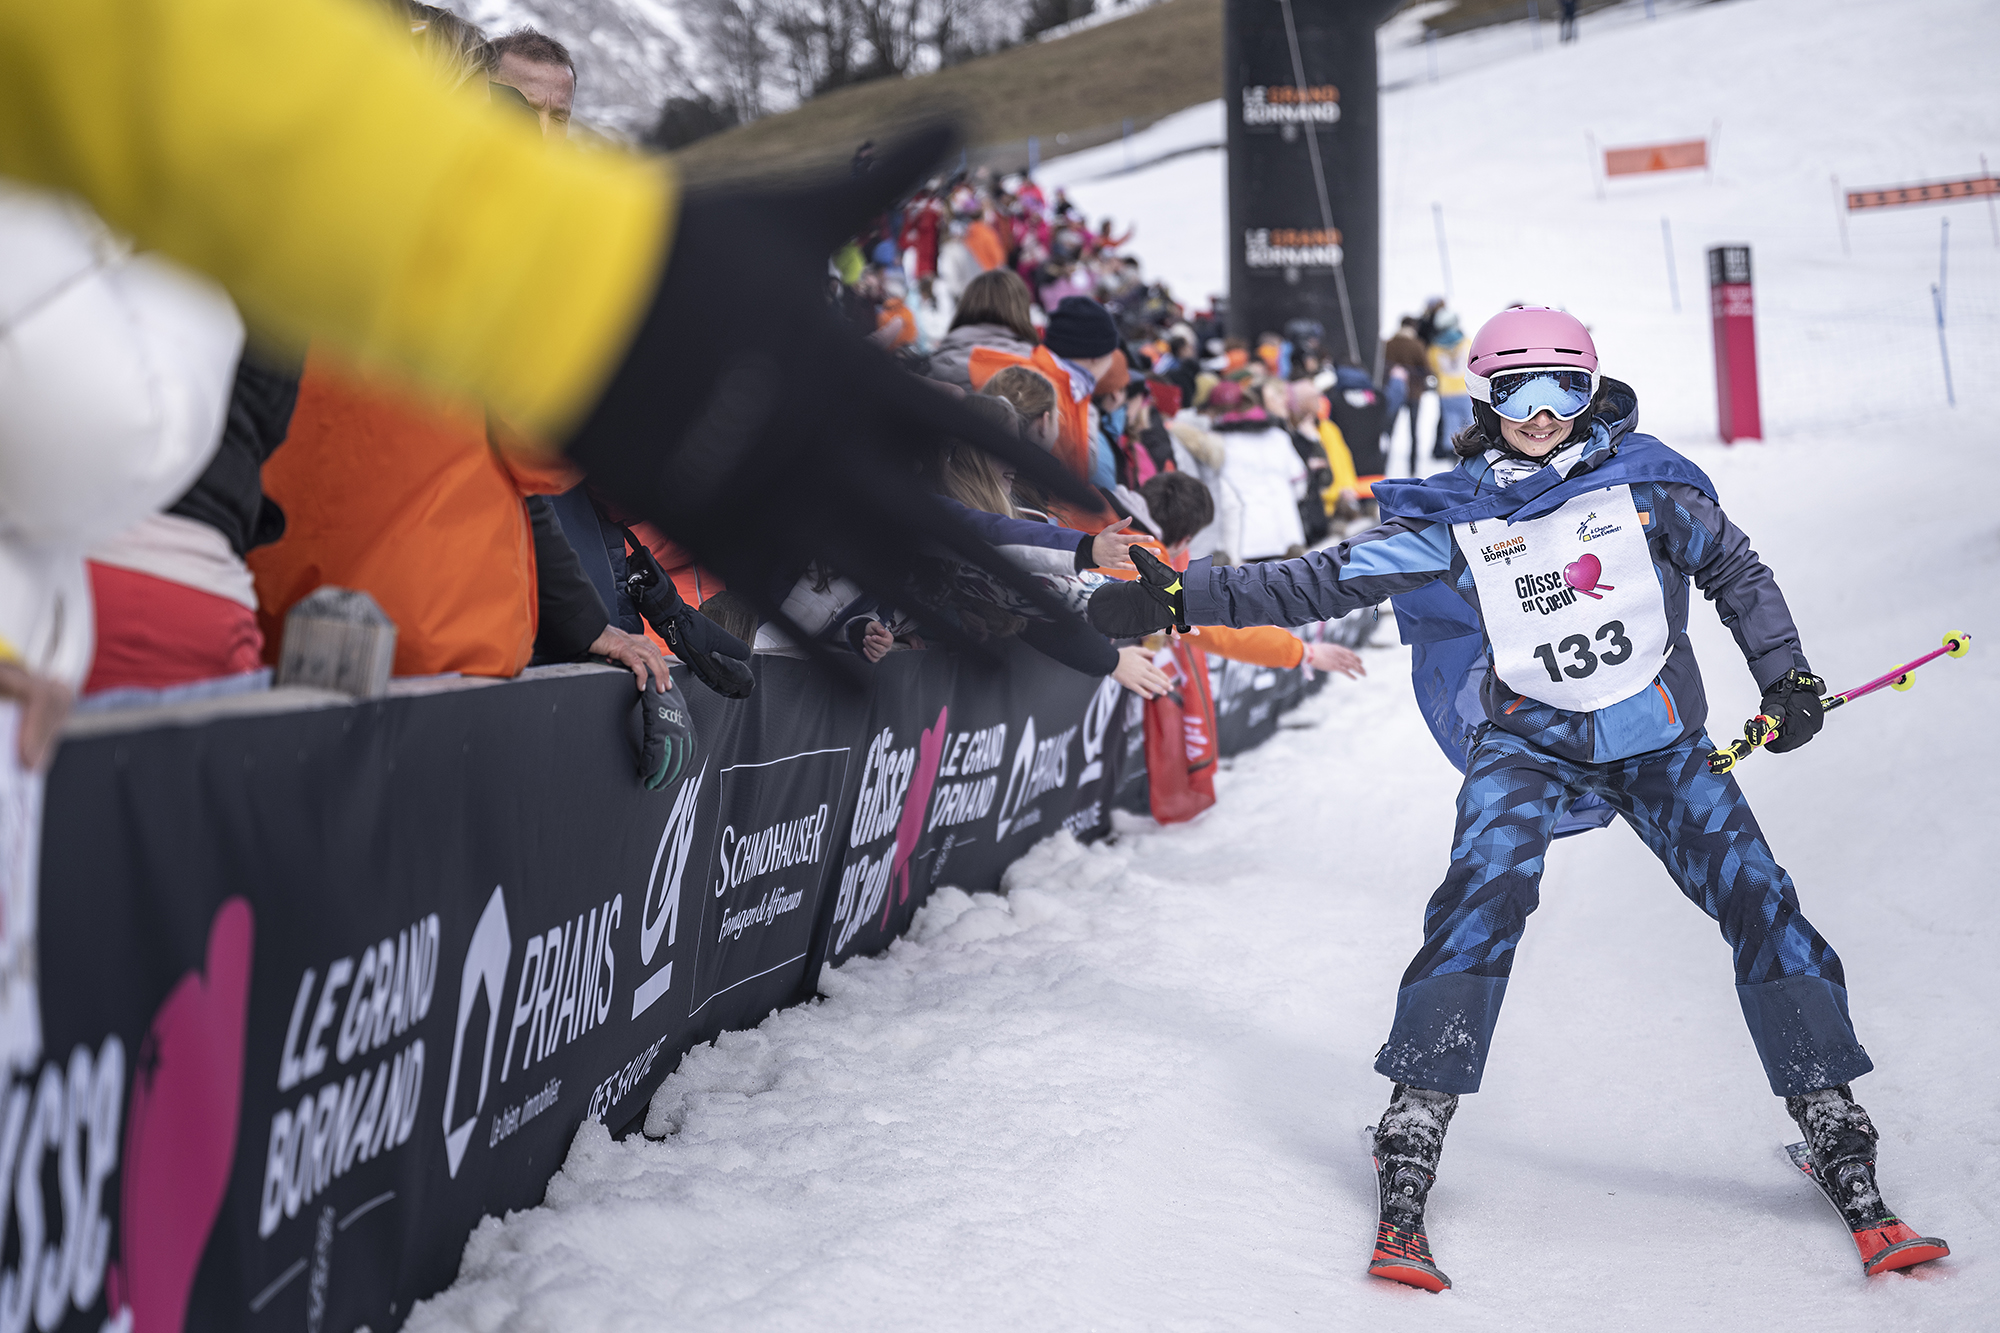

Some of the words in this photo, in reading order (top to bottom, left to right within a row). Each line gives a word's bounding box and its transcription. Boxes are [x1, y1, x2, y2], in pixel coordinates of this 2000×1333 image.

[1480, 546, 1493, 555] LE
[1493, 536, 1524, 551] GRAND
[1484, 543, 1526, 562] BORNAND
[1514, 570, 1563, 599] Glisse
[1522, 598, 1535, 613] en
[1535, 586, 1577, 615] Cœur
[1533, 620, 1633, 682] 133
[939, 732, 970, 777] LE
[961, 723, 1007, 776] GRAND
[850, 727, 915, 848] Glisse
[277, 956, 355, 1092] LE
[336, 912, 441, 1064] GRAND
[501, 893, 622, 1083] PRIAMS
[258, 1037, 426, 1239] BORNAND
